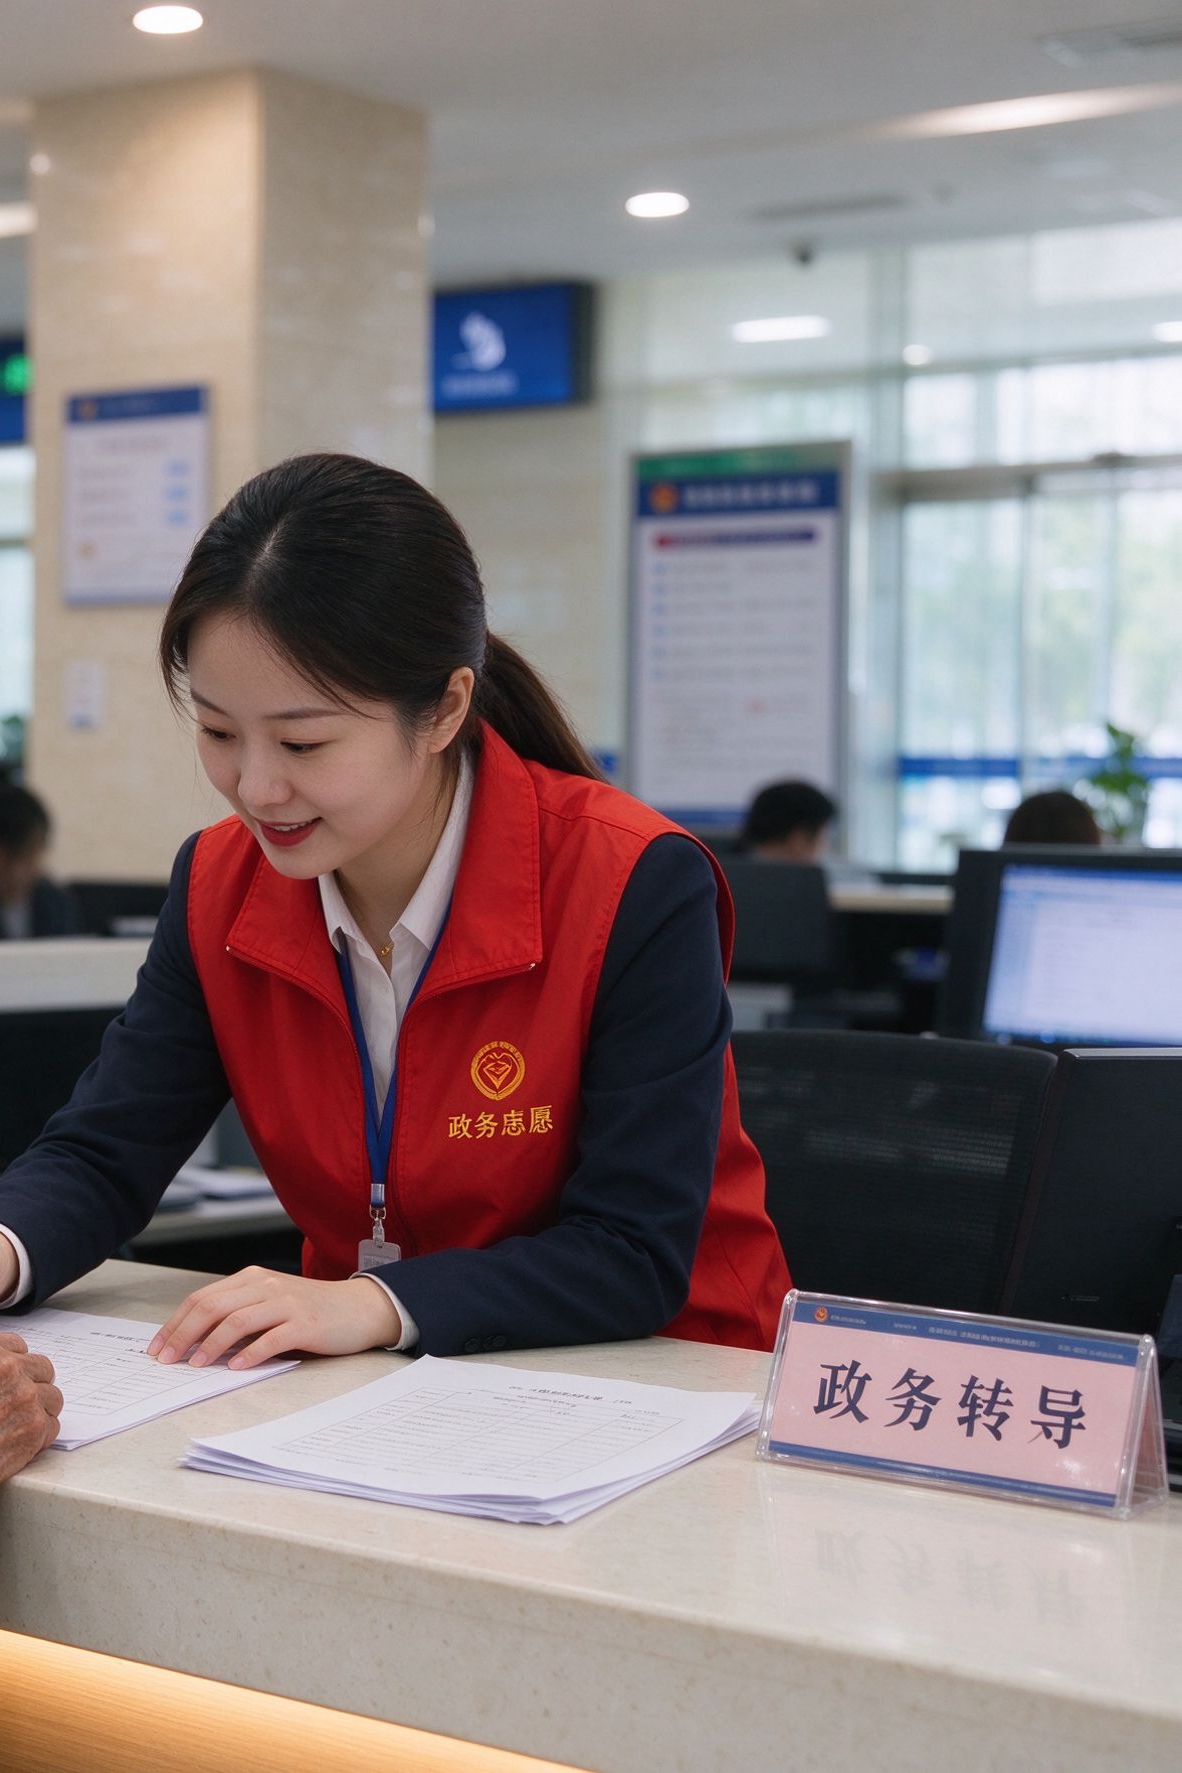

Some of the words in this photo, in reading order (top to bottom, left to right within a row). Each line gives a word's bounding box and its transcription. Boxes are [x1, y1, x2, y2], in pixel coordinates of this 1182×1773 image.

[448, 1105, 554, 1140] 政务志愿
[813, 1359, 1086, 1449] 政务转导
